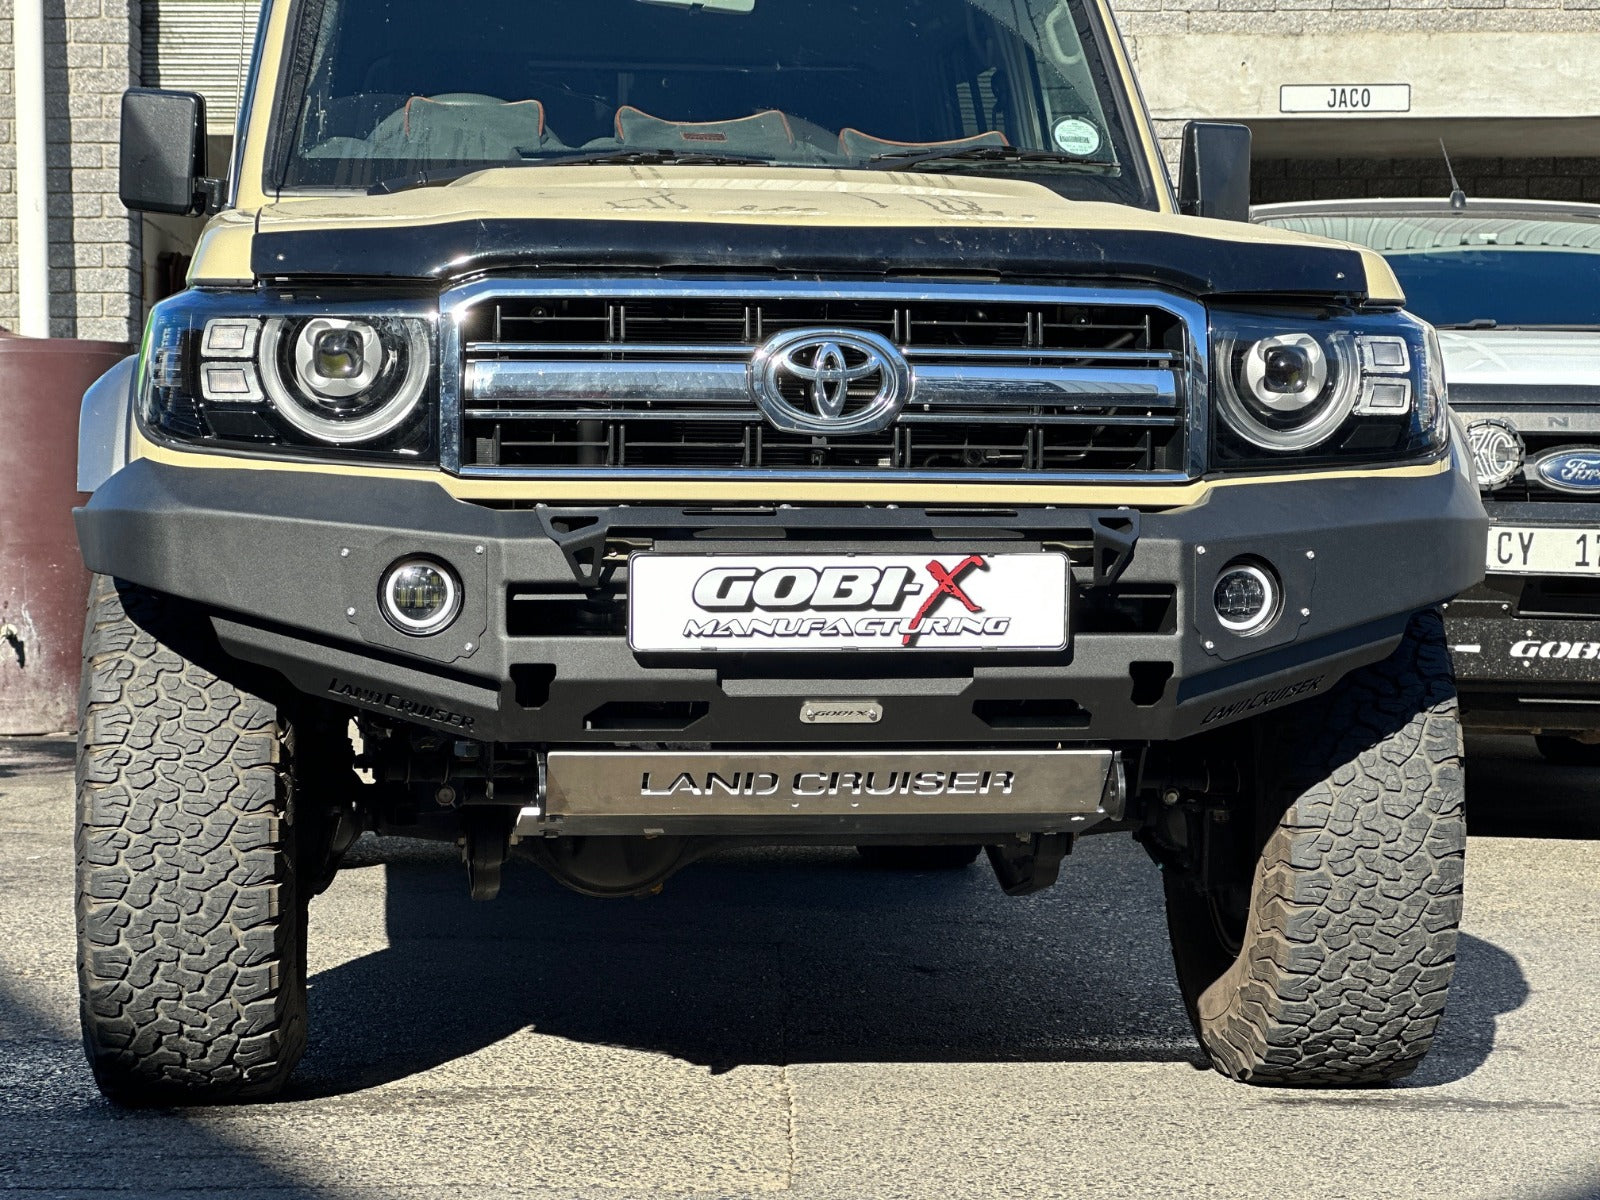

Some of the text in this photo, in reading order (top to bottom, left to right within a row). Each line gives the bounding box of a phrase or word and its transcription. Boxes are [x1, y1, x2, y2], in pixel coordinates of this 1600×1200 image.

[1327, 88, 1371, 108] JACO
[1497, 532, 1600, 567] CY 1
[692, 555, 987, 645] GOBI-X
[683, 617, 1012, 638] MANUFACTURING
[1509, 640, 1600, 659] GOB
[640, 771, 1016, 796] LAND CRUISER
